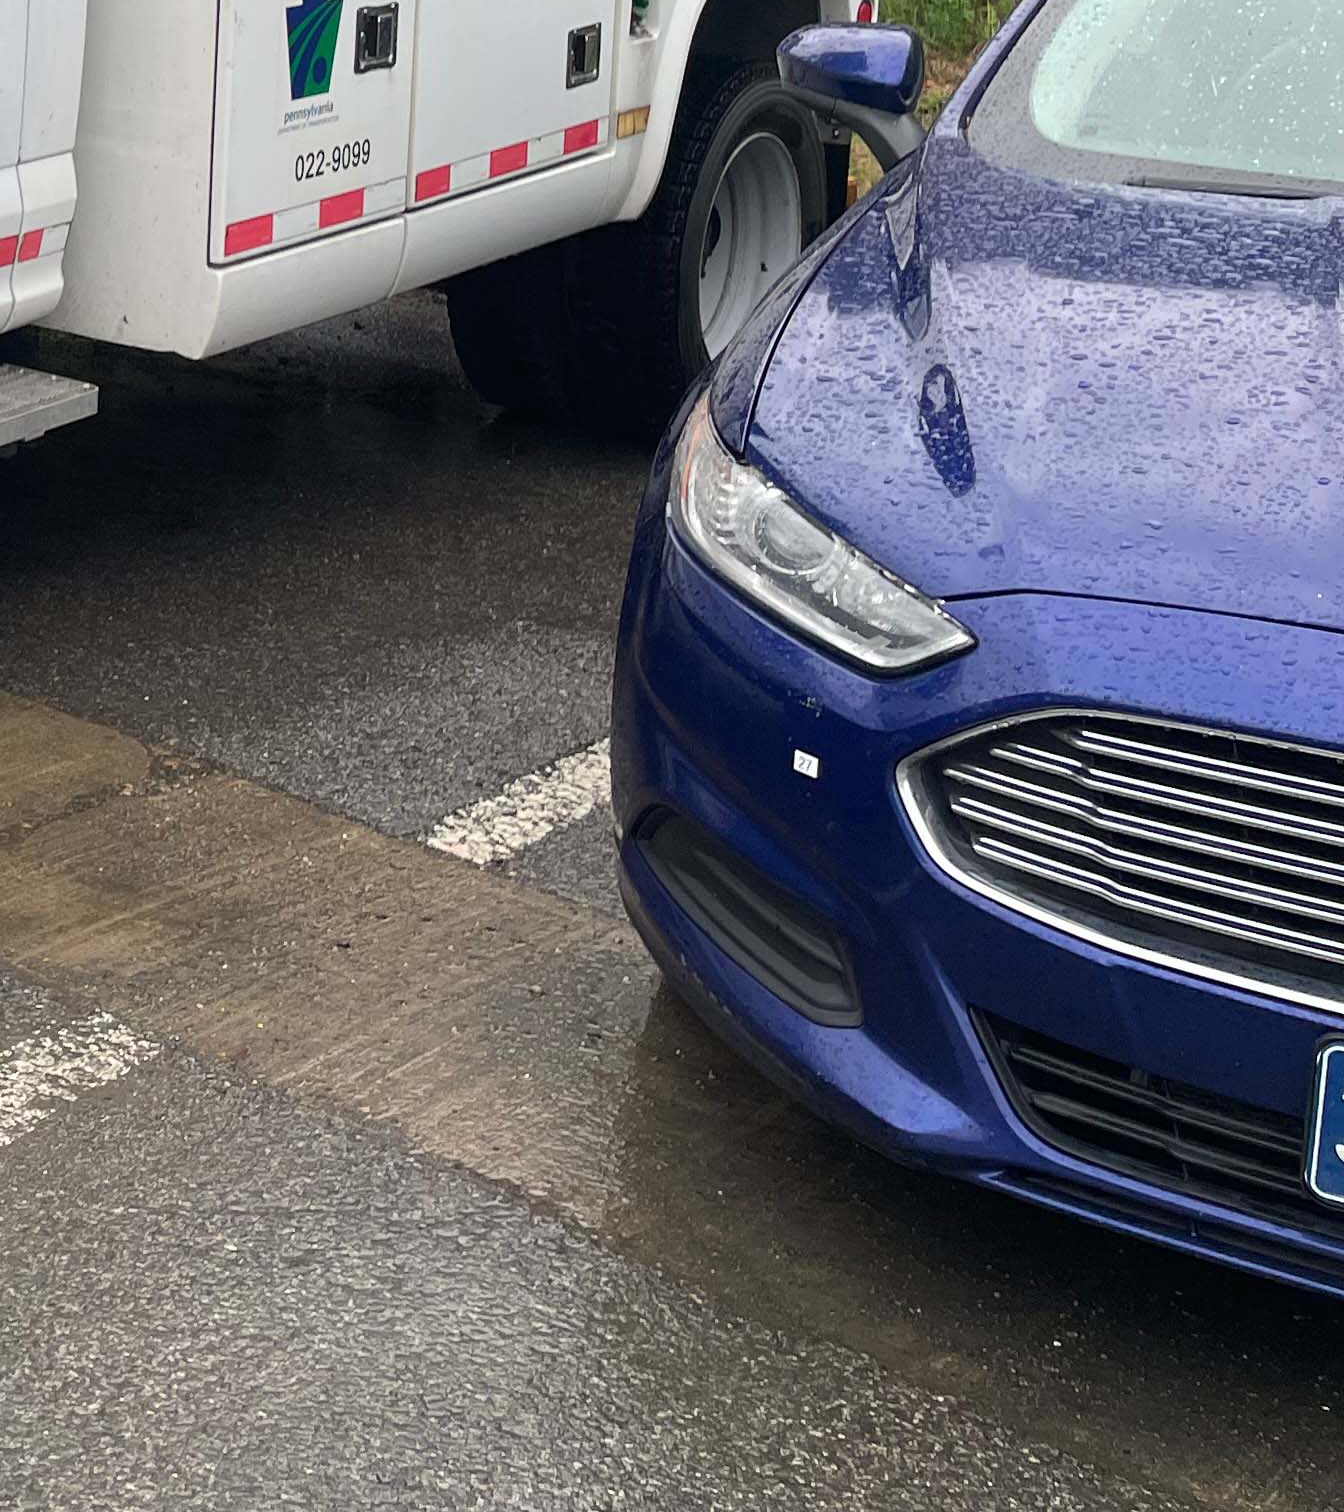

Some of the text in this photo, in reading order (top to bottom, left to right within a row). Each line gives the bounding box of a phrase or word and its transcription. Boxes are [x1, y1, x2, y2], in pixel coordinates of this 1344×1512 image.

[283, 100, 334, 125] pennsylvania
[294, 138, 371, 182] 022-9099
[798, 755, 813, 773] 27
